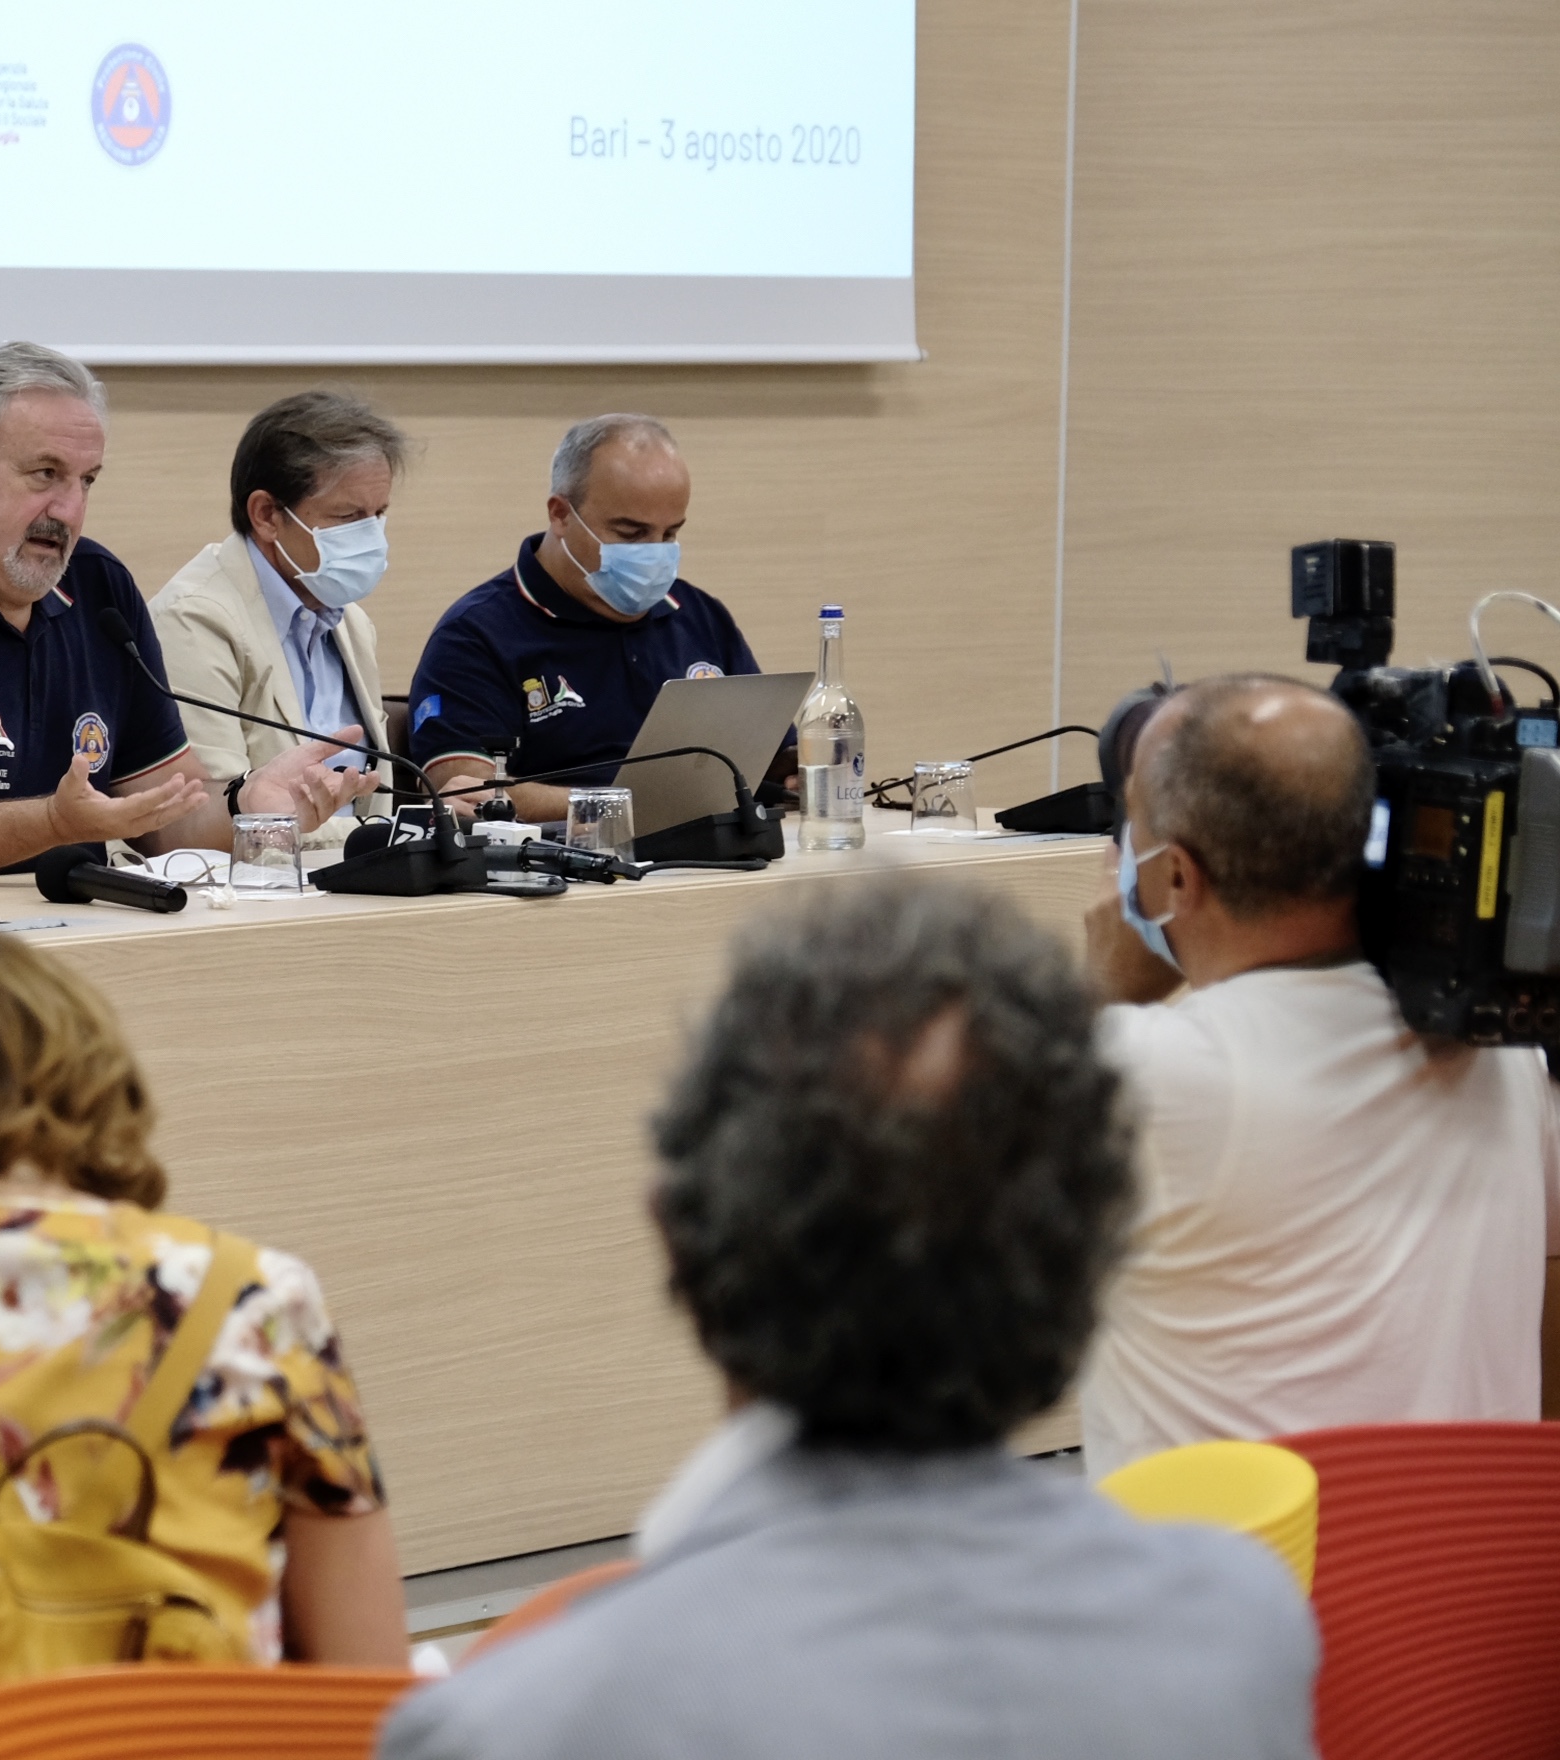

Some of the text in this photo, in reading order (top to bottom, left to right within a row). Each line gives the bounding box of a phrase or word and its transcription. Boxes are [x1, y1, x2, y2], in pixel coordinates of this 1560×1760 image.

[570, 115, 628, 158] Bari
[661, 118, 676, 159] 3
[684, 126, 783, 172] agosto
[791, 124, 861, 165] 2020
